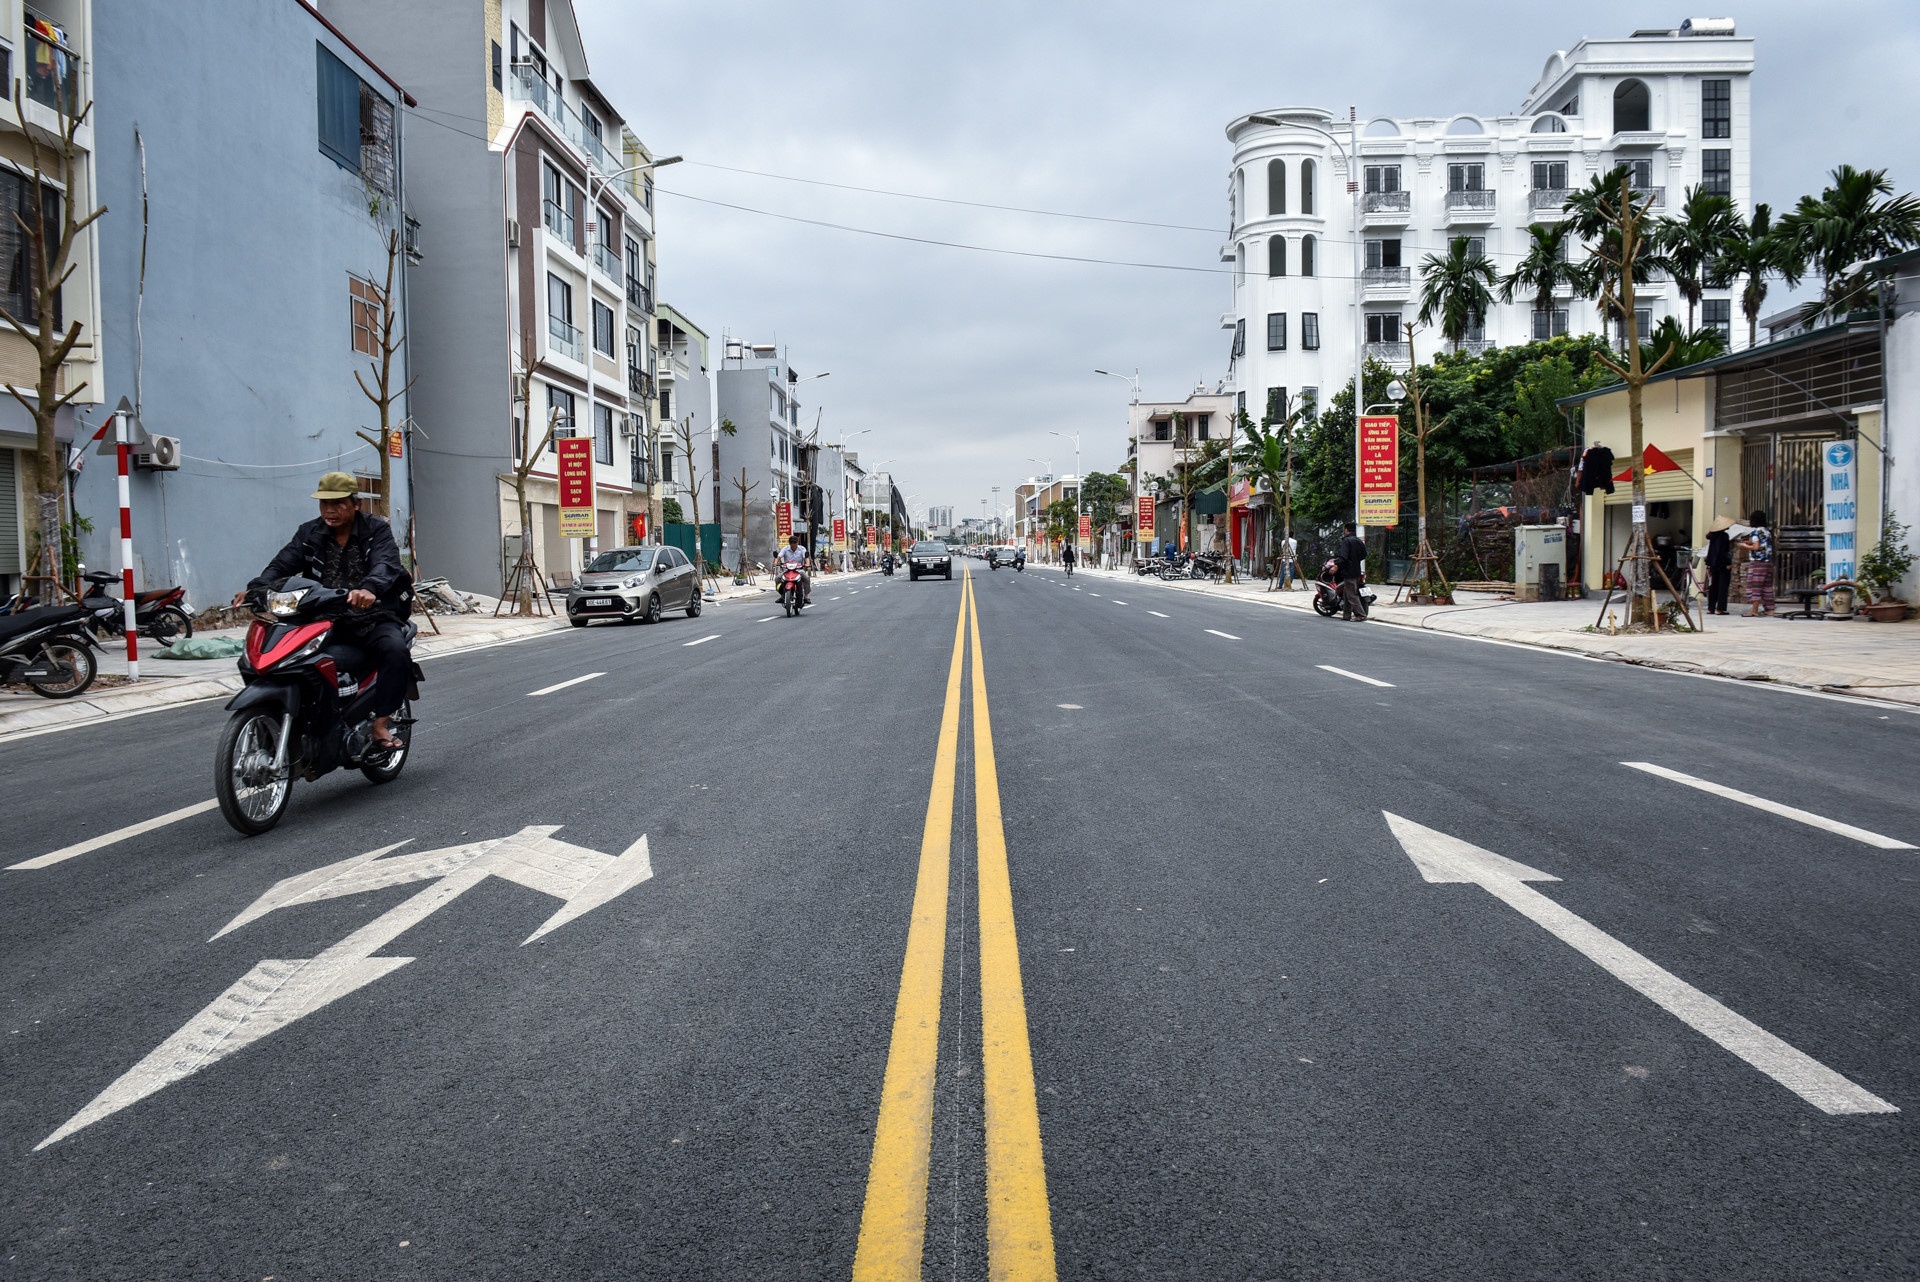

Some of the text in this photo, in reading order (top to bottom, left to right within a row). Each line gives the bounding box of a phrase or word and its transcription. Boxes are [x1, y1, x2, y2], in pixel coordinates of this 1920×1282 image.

[1830, 469, 1850, 491] NHÀ
[1826, 496, 1856, 521] THUỐC
[1830, 532, 1854, 550] MINH
